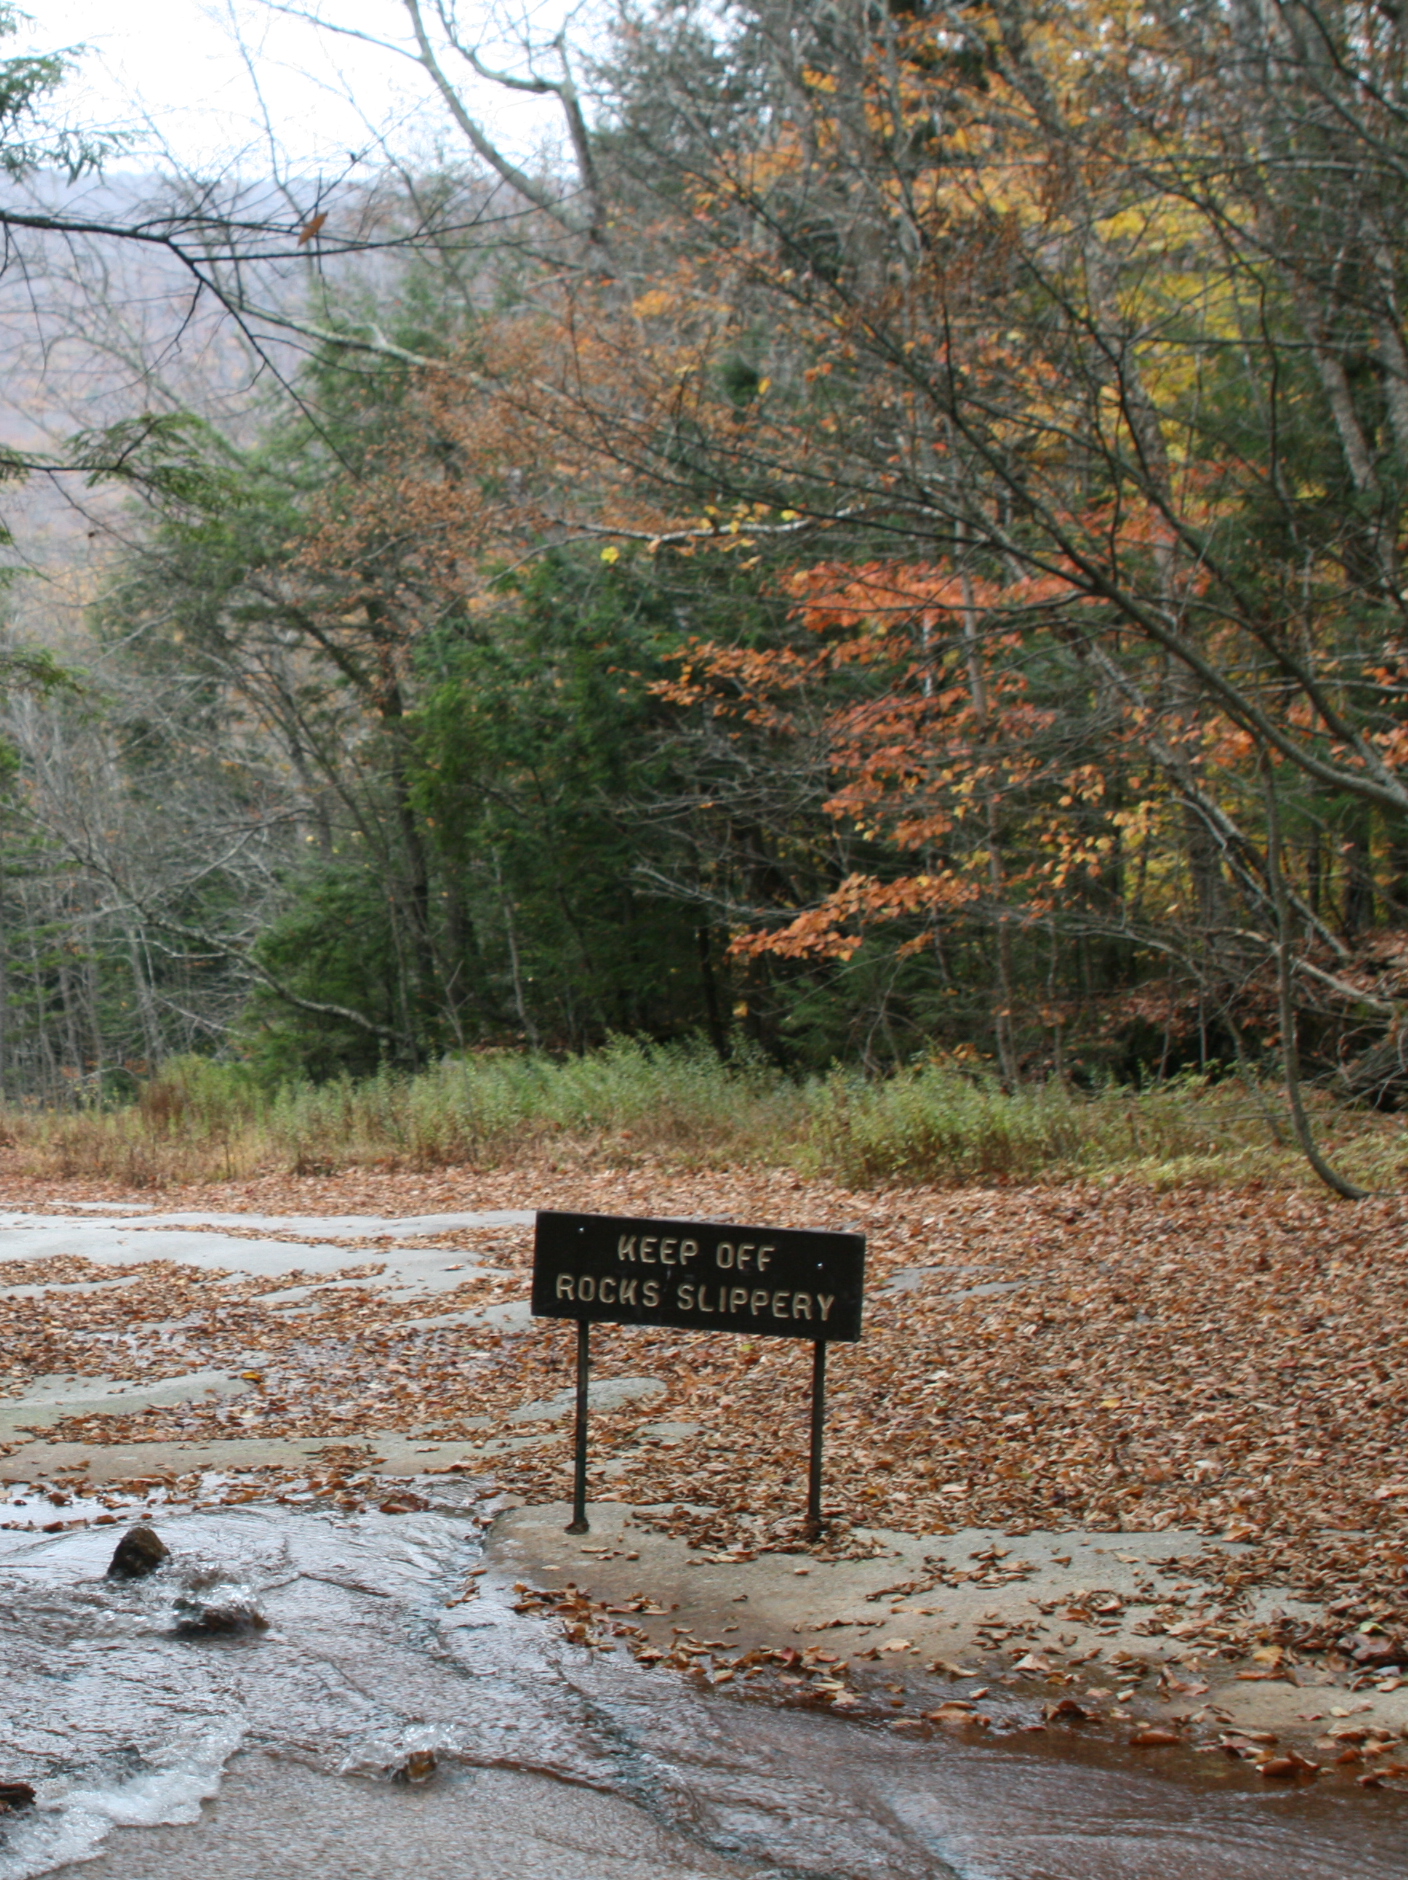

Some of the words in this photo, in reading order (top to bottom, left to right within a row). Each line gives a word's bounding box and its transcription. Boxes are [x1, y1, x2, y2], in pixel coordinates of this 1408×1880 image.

[617, 1235, 699, 1266] KEEP
[716, 1242, 776, 1272] OFF
[556, 1273, 660, 1308] ROCKS
[677, 1284, 835, 1321] SLIPPERY
